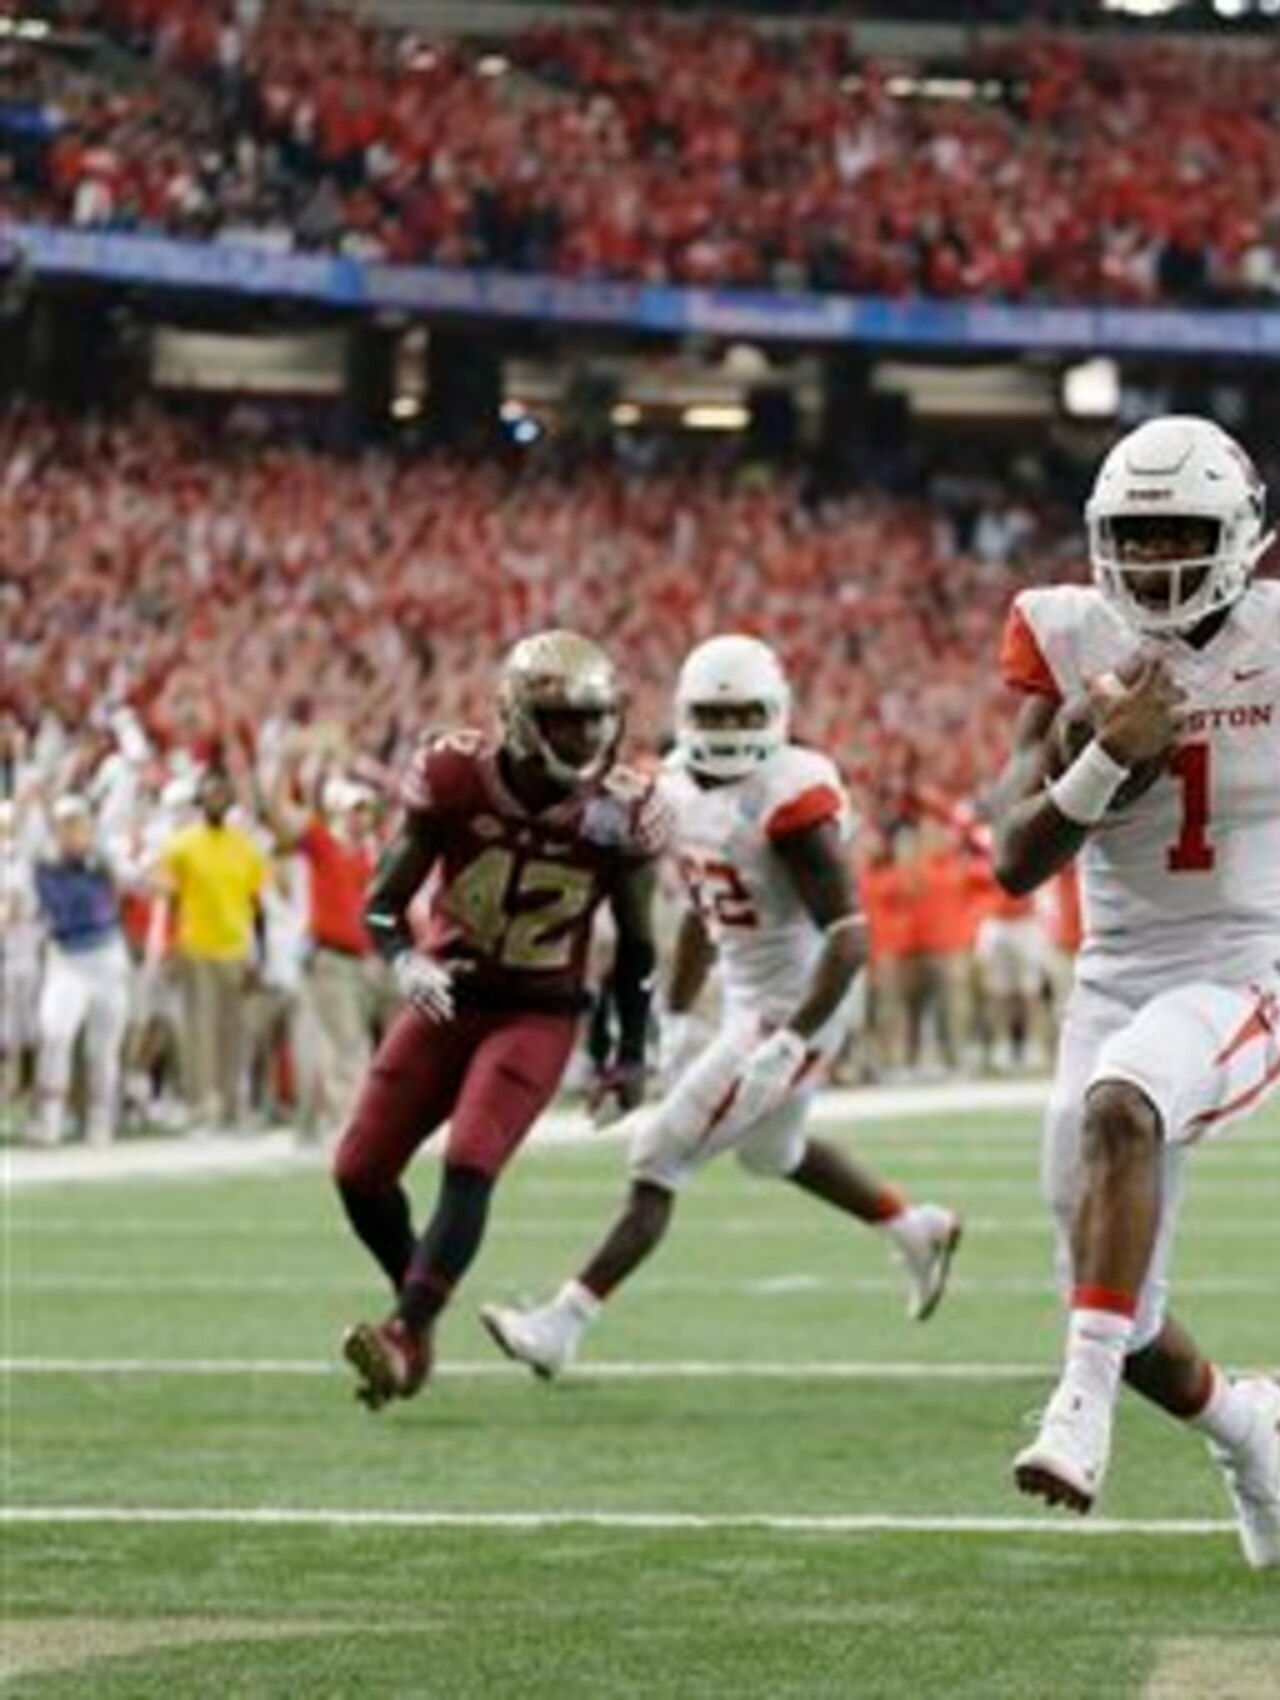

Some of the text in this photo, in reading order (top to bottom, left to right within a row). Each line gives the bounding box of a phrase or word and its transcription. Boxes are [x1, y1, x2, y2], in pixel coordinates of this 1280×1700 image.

[1187, 704, 1274, 732] STON
[1166, 741, 1216, 872] 1
[444, 848, 596, 967] 42
